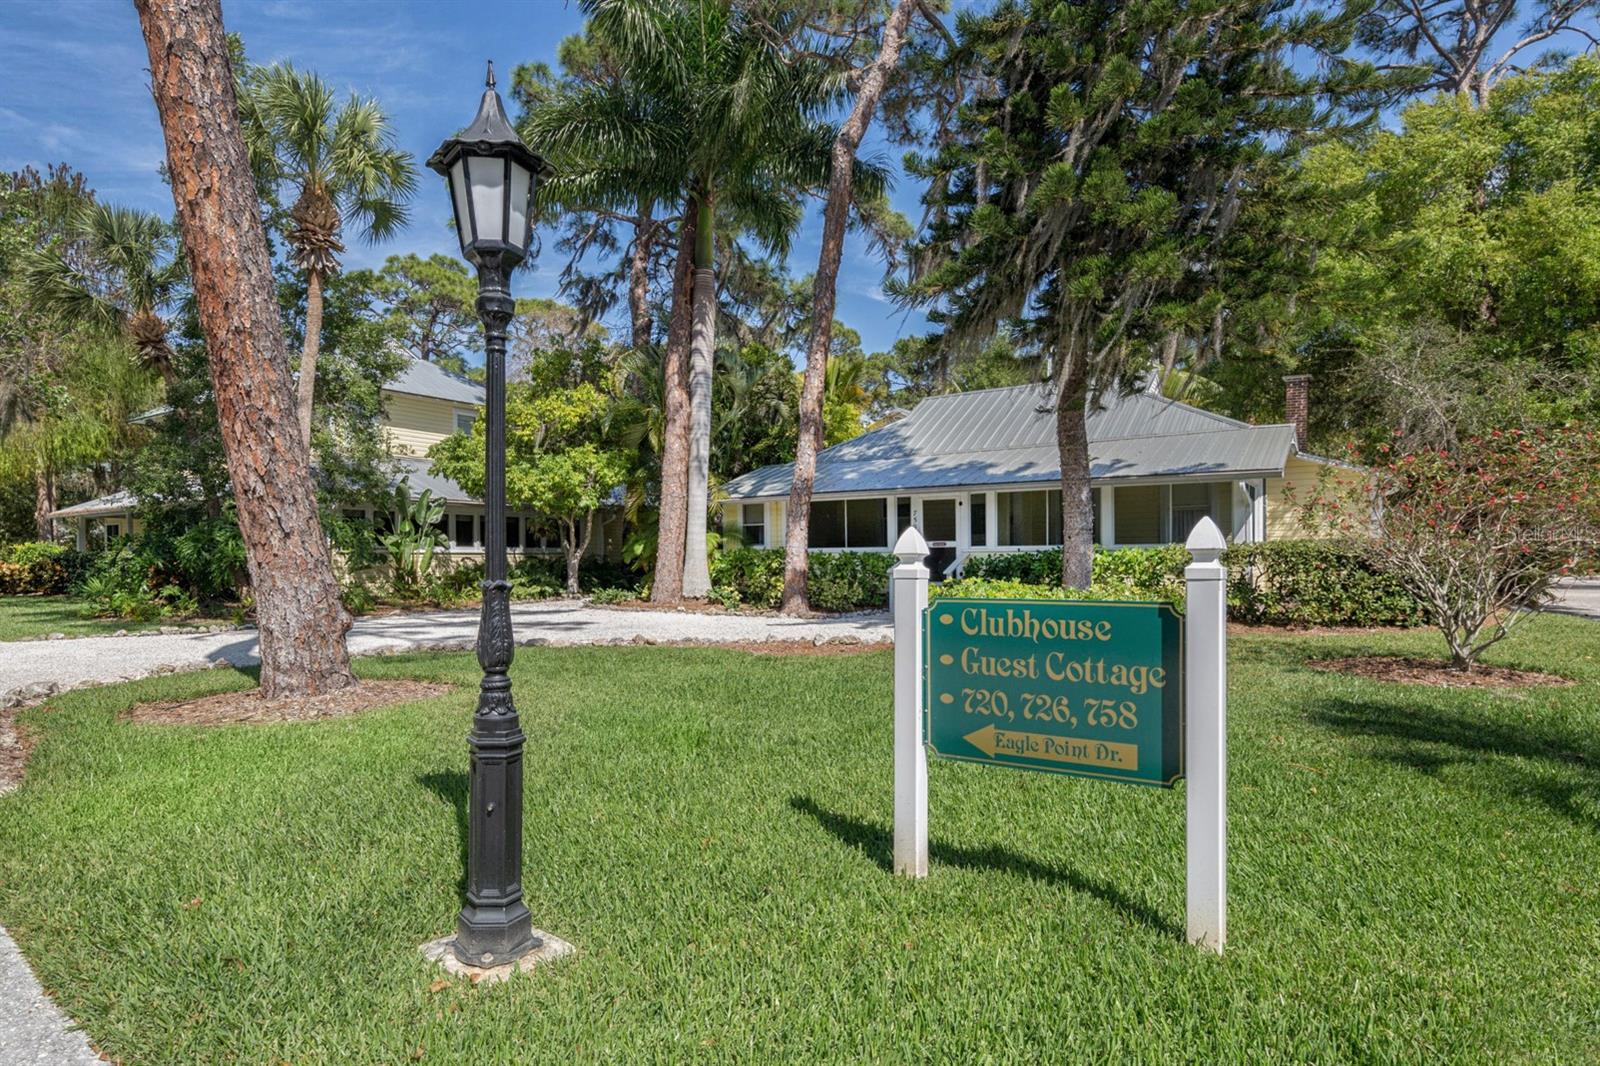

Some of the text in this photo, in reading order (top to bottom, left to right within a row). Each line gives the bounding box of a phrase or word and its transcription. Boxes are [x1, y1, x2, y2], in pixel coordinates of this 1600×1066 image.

[961, 608, 1112, 643] Clubhouse
[961, 647, 1167, 695] Guest Cottage
[961, 688, 1138, 730] 720, 726, 758
[994, 732, 1123, 762] Eagle Point Dr.
